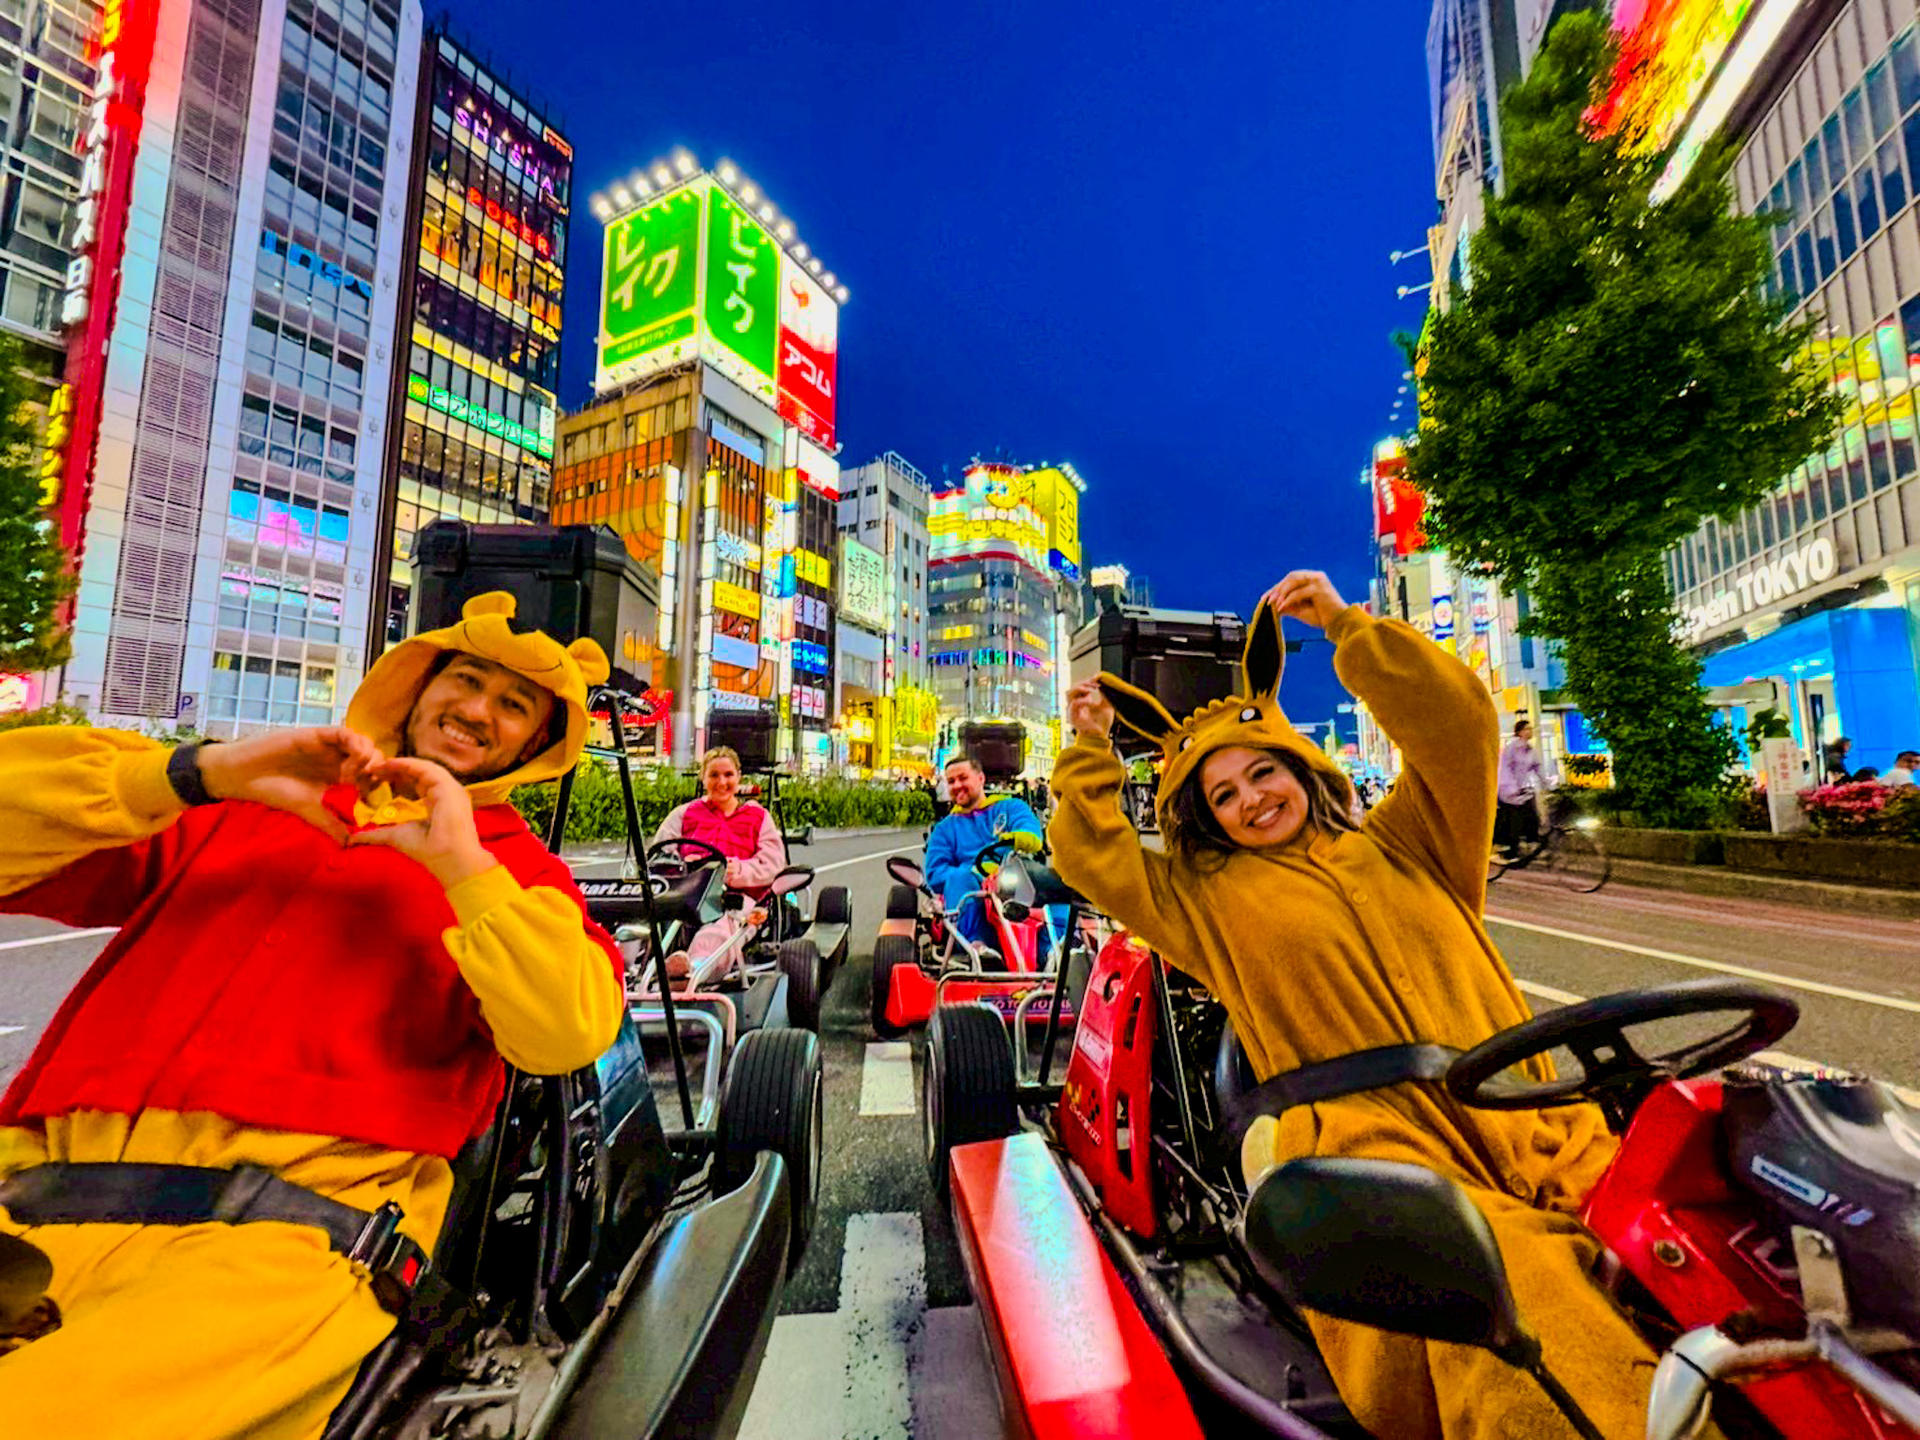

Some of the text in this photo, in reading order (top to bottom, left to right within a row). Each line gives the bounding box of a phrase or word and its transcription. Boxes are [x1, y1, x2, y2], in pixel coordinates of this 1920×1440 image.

[455, 107, 555, 197] SHISHA
[468, 186, 550, 257] POKER
[611, 227, 680, 311] レイク
[724, 214, 757, 333] レイク
[784, 340, 832, 398] アコム
[1736, 537, 1834, 612] TOKYO
